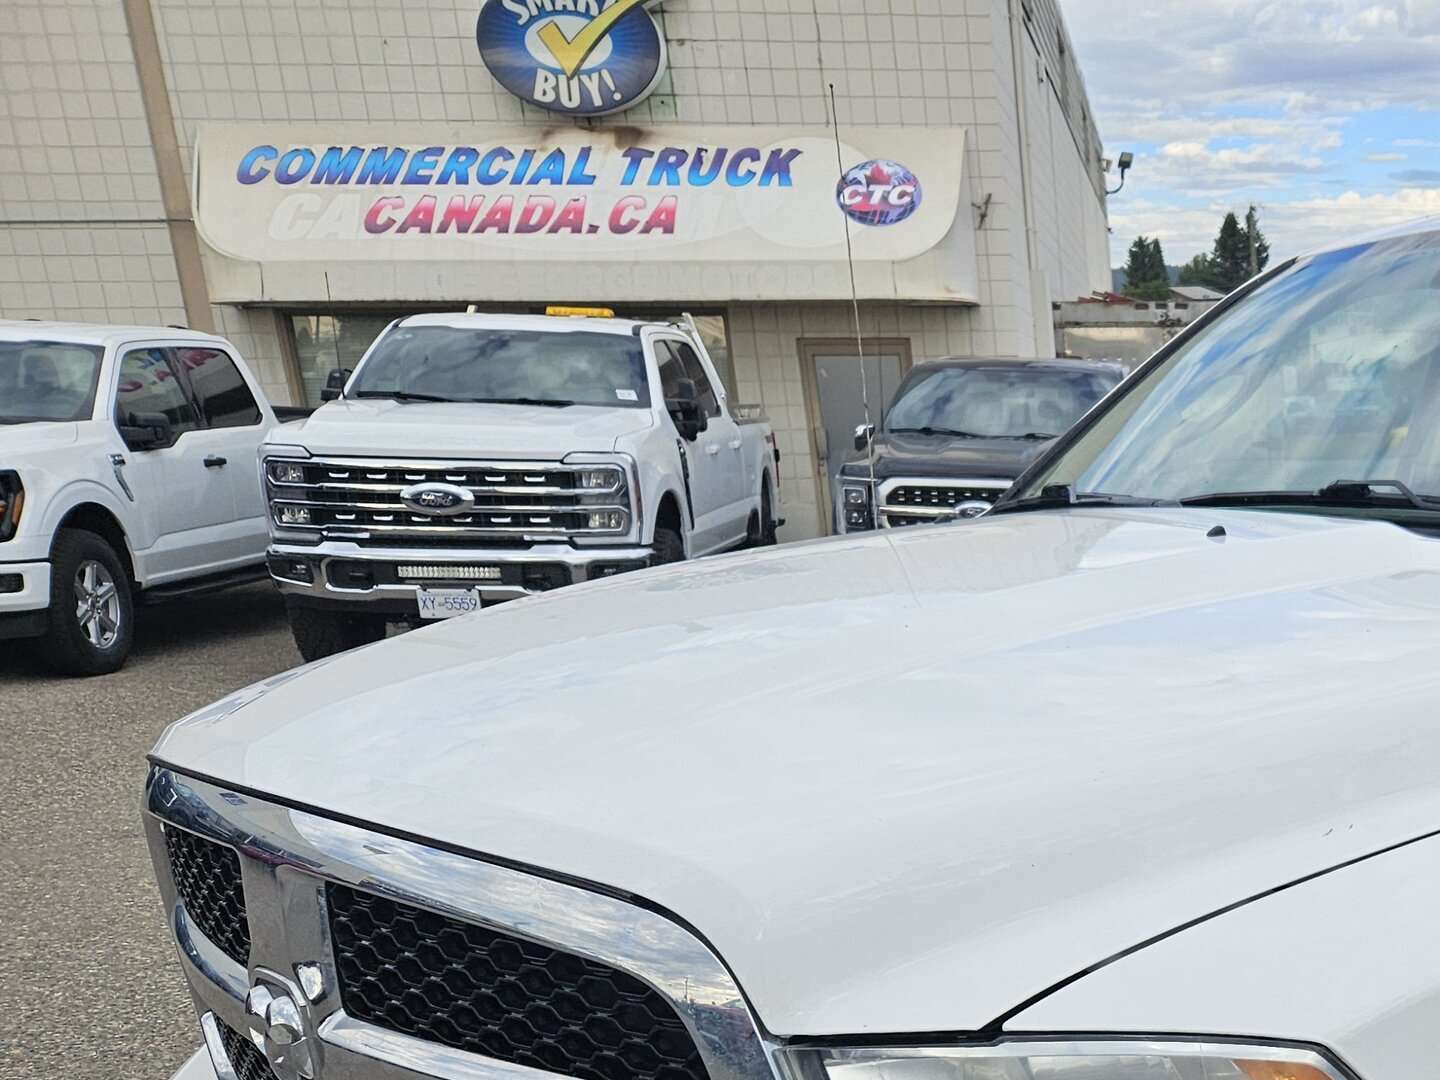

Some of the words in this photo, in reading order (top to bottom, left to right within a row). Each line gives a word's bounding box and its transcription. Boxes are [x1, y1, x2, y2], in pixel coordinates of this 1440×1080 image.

[533, 68, 622, 108] BUY!
[236, 144, 597, 186] COMMERCIAL
[619, 146, 804, 187] TRUCK
[363, 194, 679, 235] CANADA.CA
[839, 183, 916, 206] CTC
